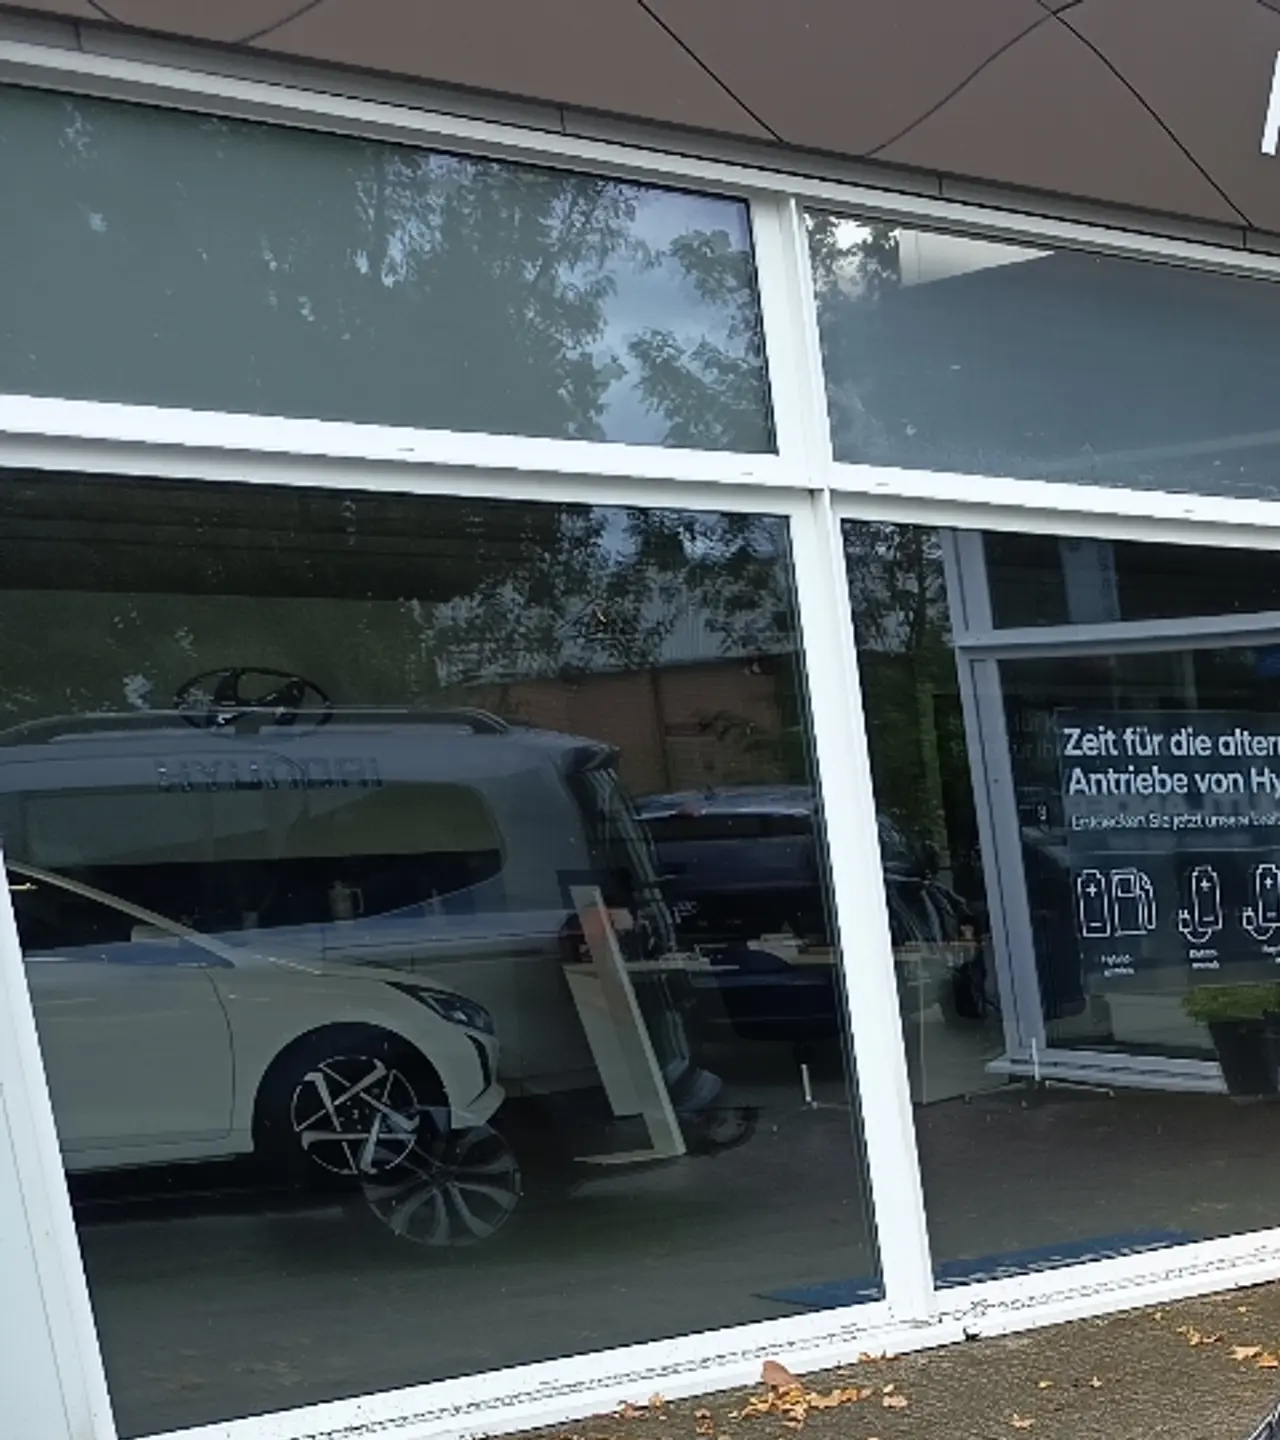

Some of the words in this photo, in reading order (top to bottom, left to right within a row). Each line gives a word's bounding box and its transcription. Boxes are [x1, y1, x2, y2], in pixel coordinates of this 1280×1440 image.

[1063, 726, 1118, 756] Zeit
[1123, 726, 1164, 756] für
[1170, 727, 1212, 756] die
[1069, 765, 1188, 796] Antriebe
[1195, 773, 1244, 794] von
